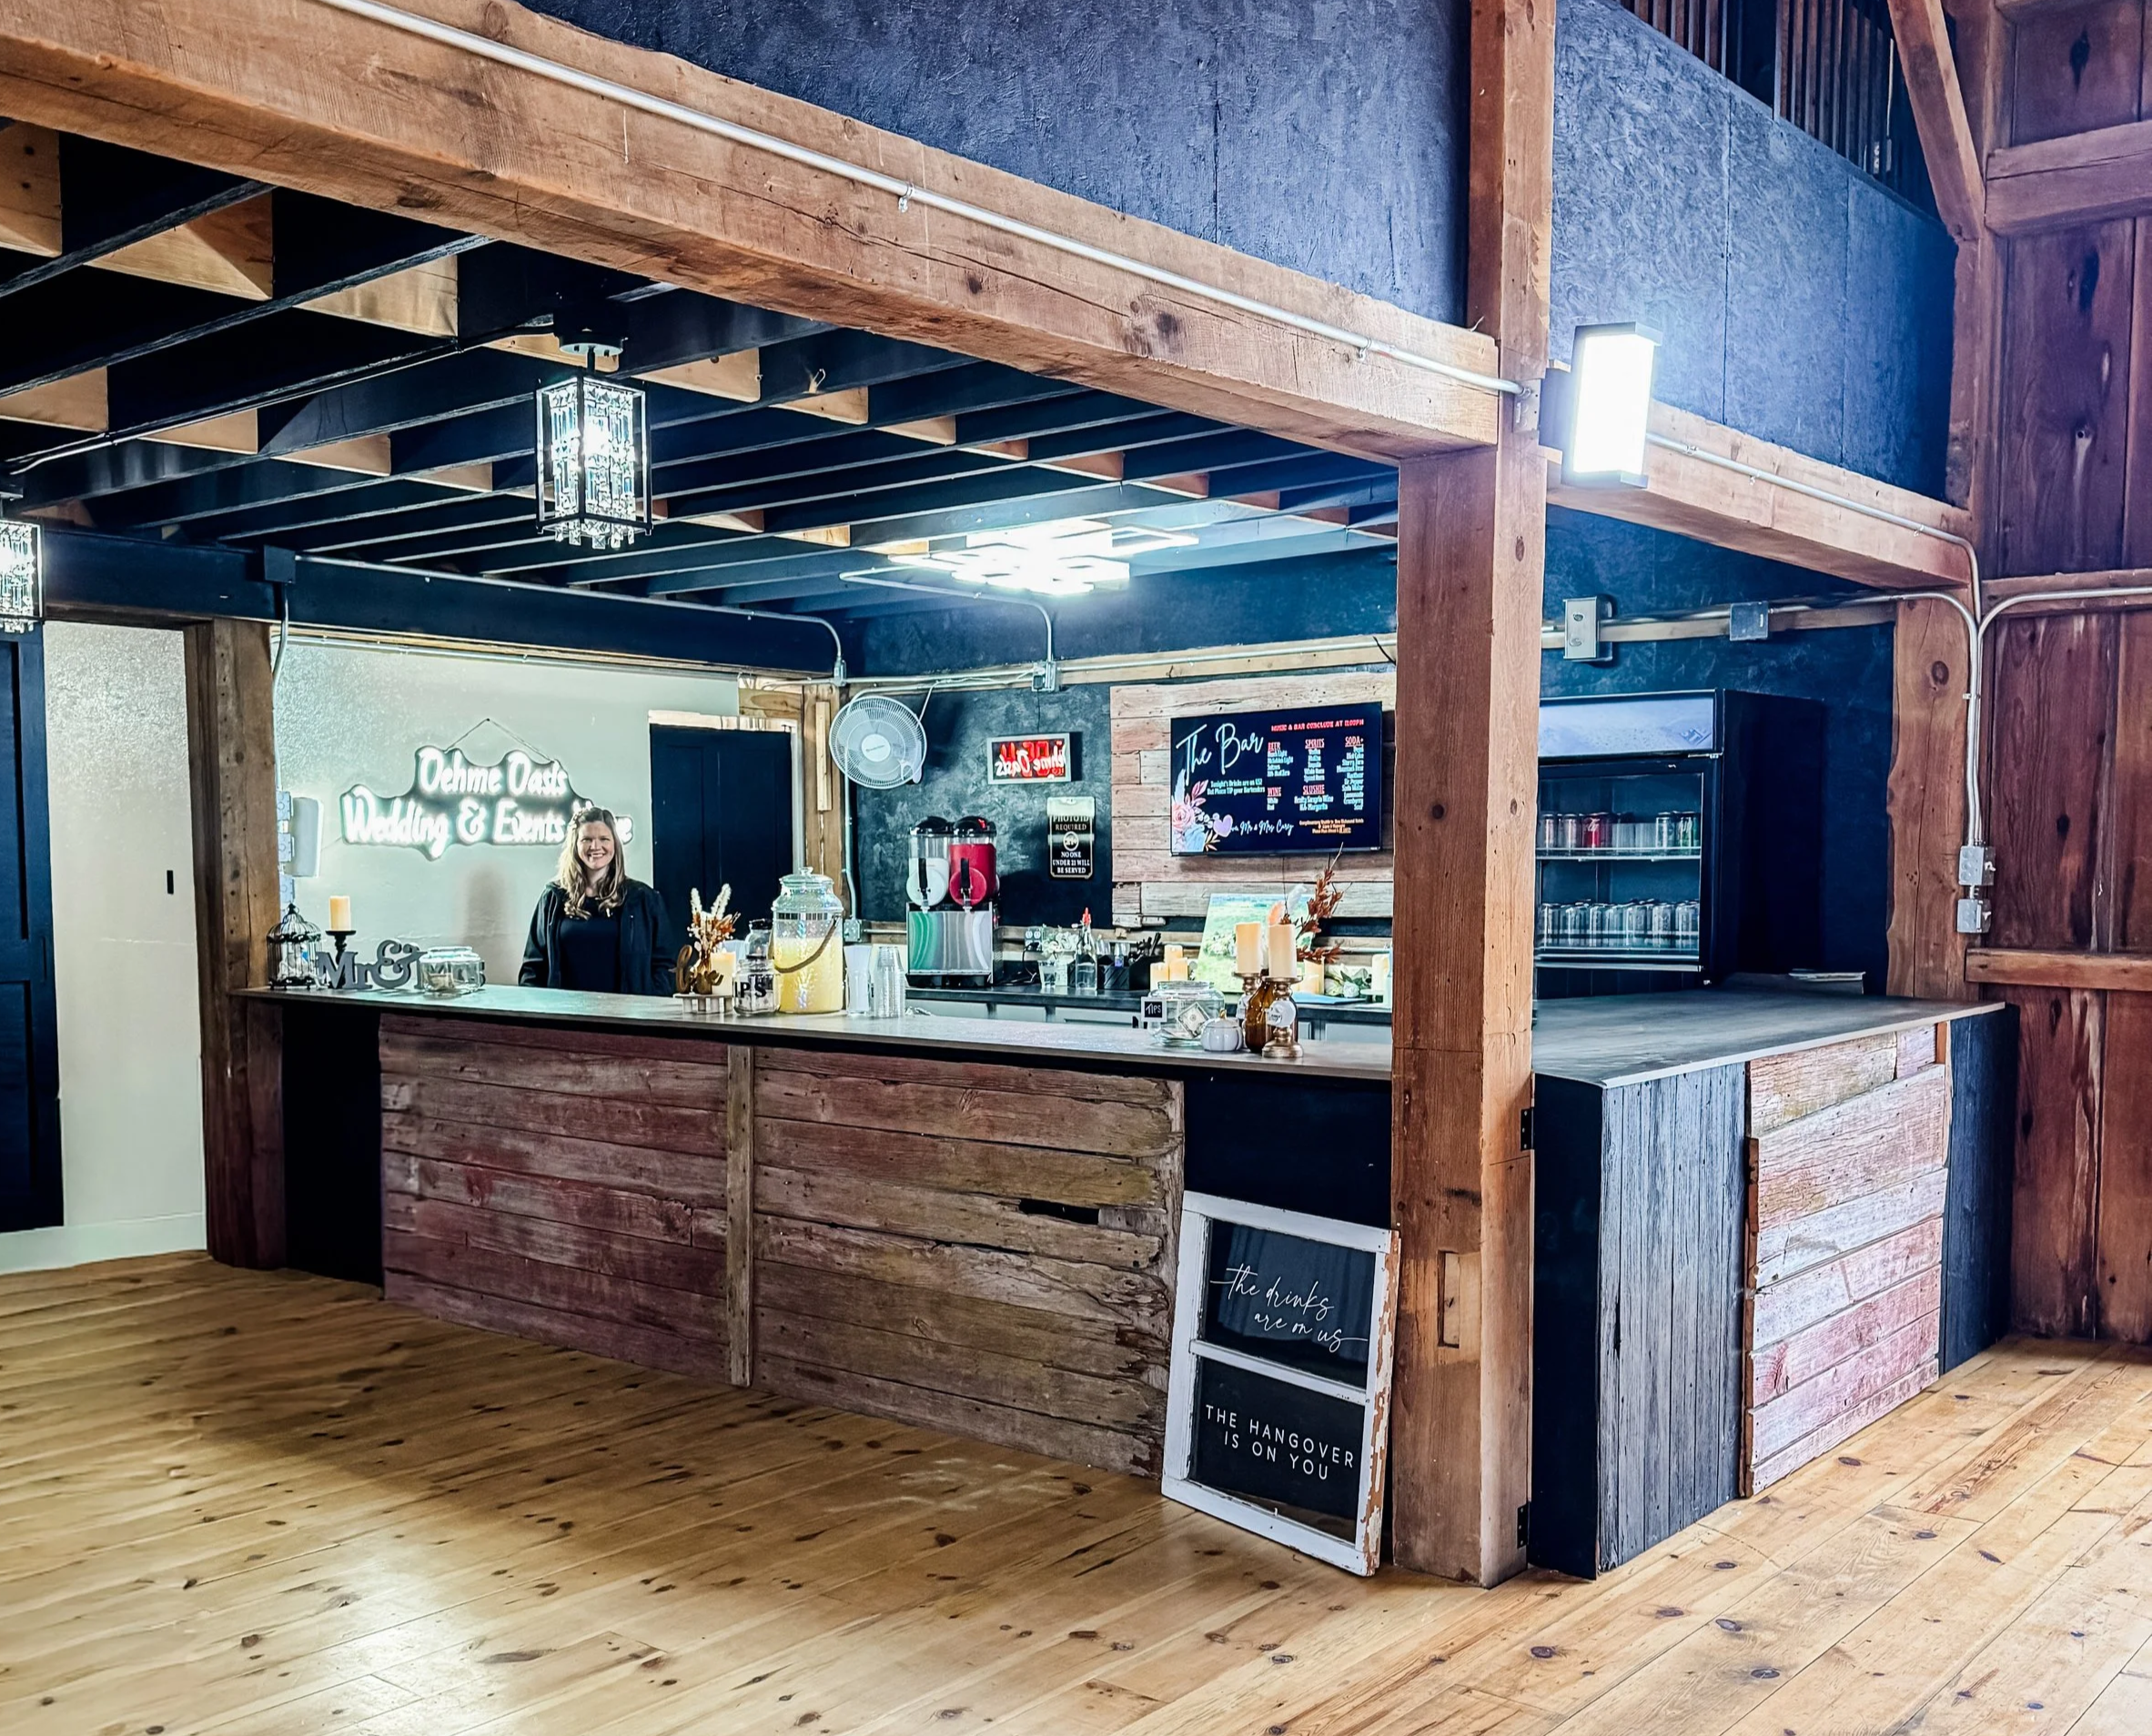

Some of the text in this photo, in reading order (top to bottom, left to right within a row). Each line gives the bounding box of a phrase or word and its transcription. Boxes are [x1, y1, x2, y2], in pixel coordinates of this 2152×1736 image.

[1176, 722, 1264, 786] The Bar
[1268, 742, 1280, 752] BEER
[1305, 738, 1324, 749] SPIRITS
[419, 751, 567, 795] Oehme Oasis
[1268, 787, 1281, 796] WINE
[1303, 784, 1325, 795] SLUSHIE
[342, 788, 449, 858] Wedding
[458, 798, 487, 843] &
[493, 799, 566, 843] Events
[318, 951, 373, 990] Mr
[376, 939, 420, 990] &
[733, 981, 767, 998] IPS
[1209, 1263, 1334, 1321] the drinks
[1254, 1312, 1369, 1353] are on us
[1206, 1404, 1354, 1469] THE HANGOVER
[1224, 1430, 1329, 1480] IS ON YOU
